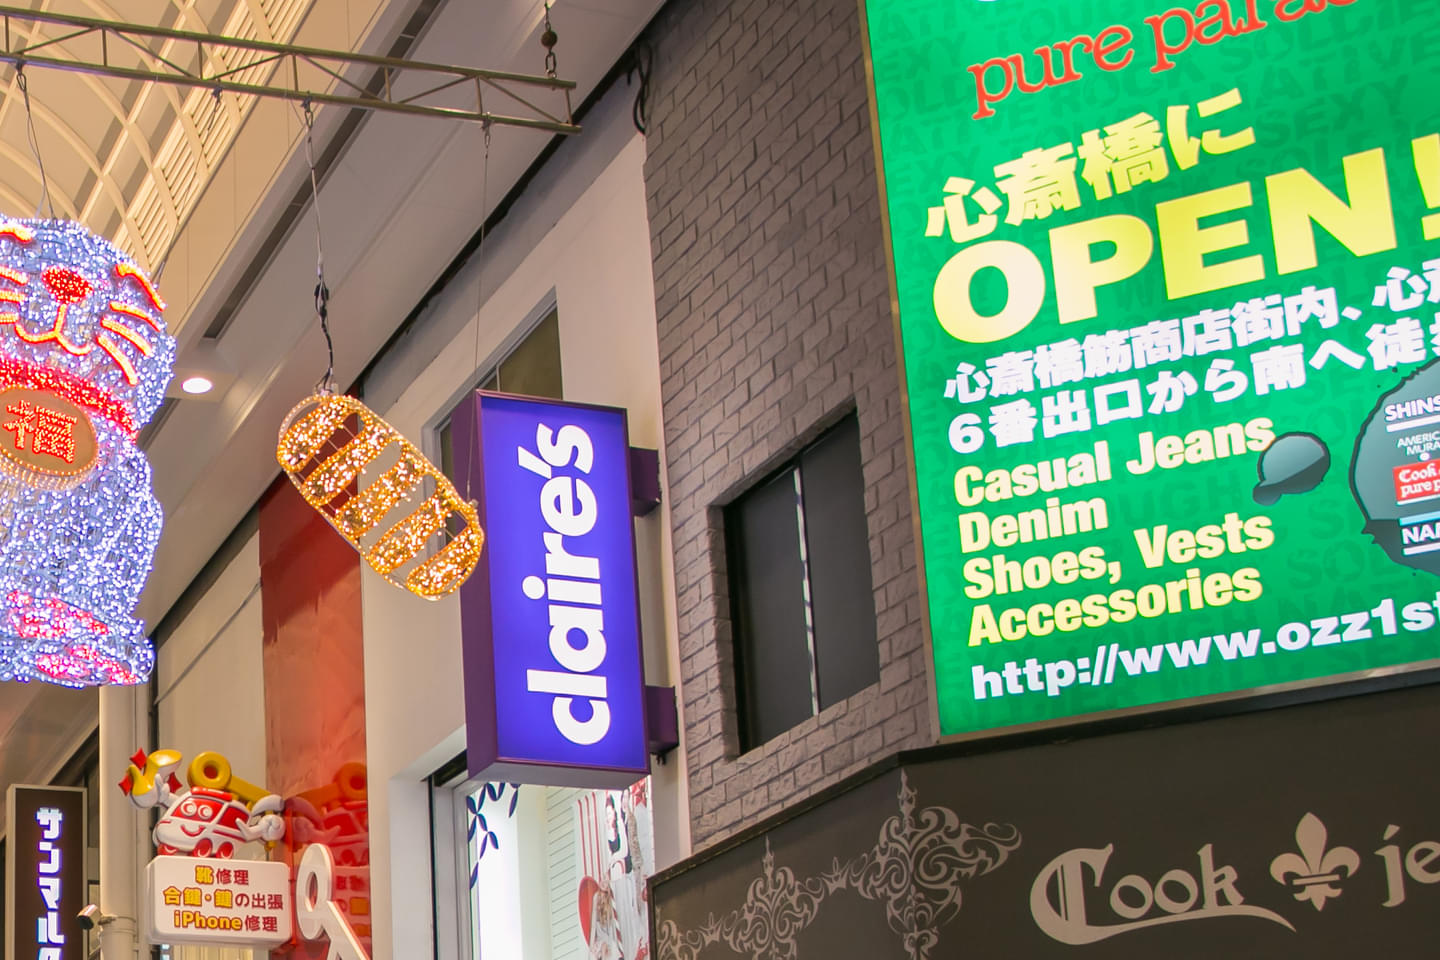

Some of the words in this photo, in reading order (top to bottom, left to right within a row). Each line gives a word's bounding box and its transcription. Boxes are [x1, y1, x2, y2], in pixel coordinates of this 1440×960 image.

[967, 24, 1134, 119] pure
[924, 87, 1256, 244] 心斎橋に
[948, 312, 1440, 453] 6番出口から南へ徒
[2, 399, 78, 464] 福
[954, 440, 1111, 506] Casual
[1126, 417, 1276, 475] Jeans
[959, 497, 1109, 553] Denim
[963, 546, 1121, 599] Shoes,
[1134, 512, 1275, 568] Vests
[517, 423, 611, 746] claire's
[968, 567, 1262, 647] Accessories
[174, 910, 278, 933] iPhone修理
[1030, 842, 1296, 945] Cook
